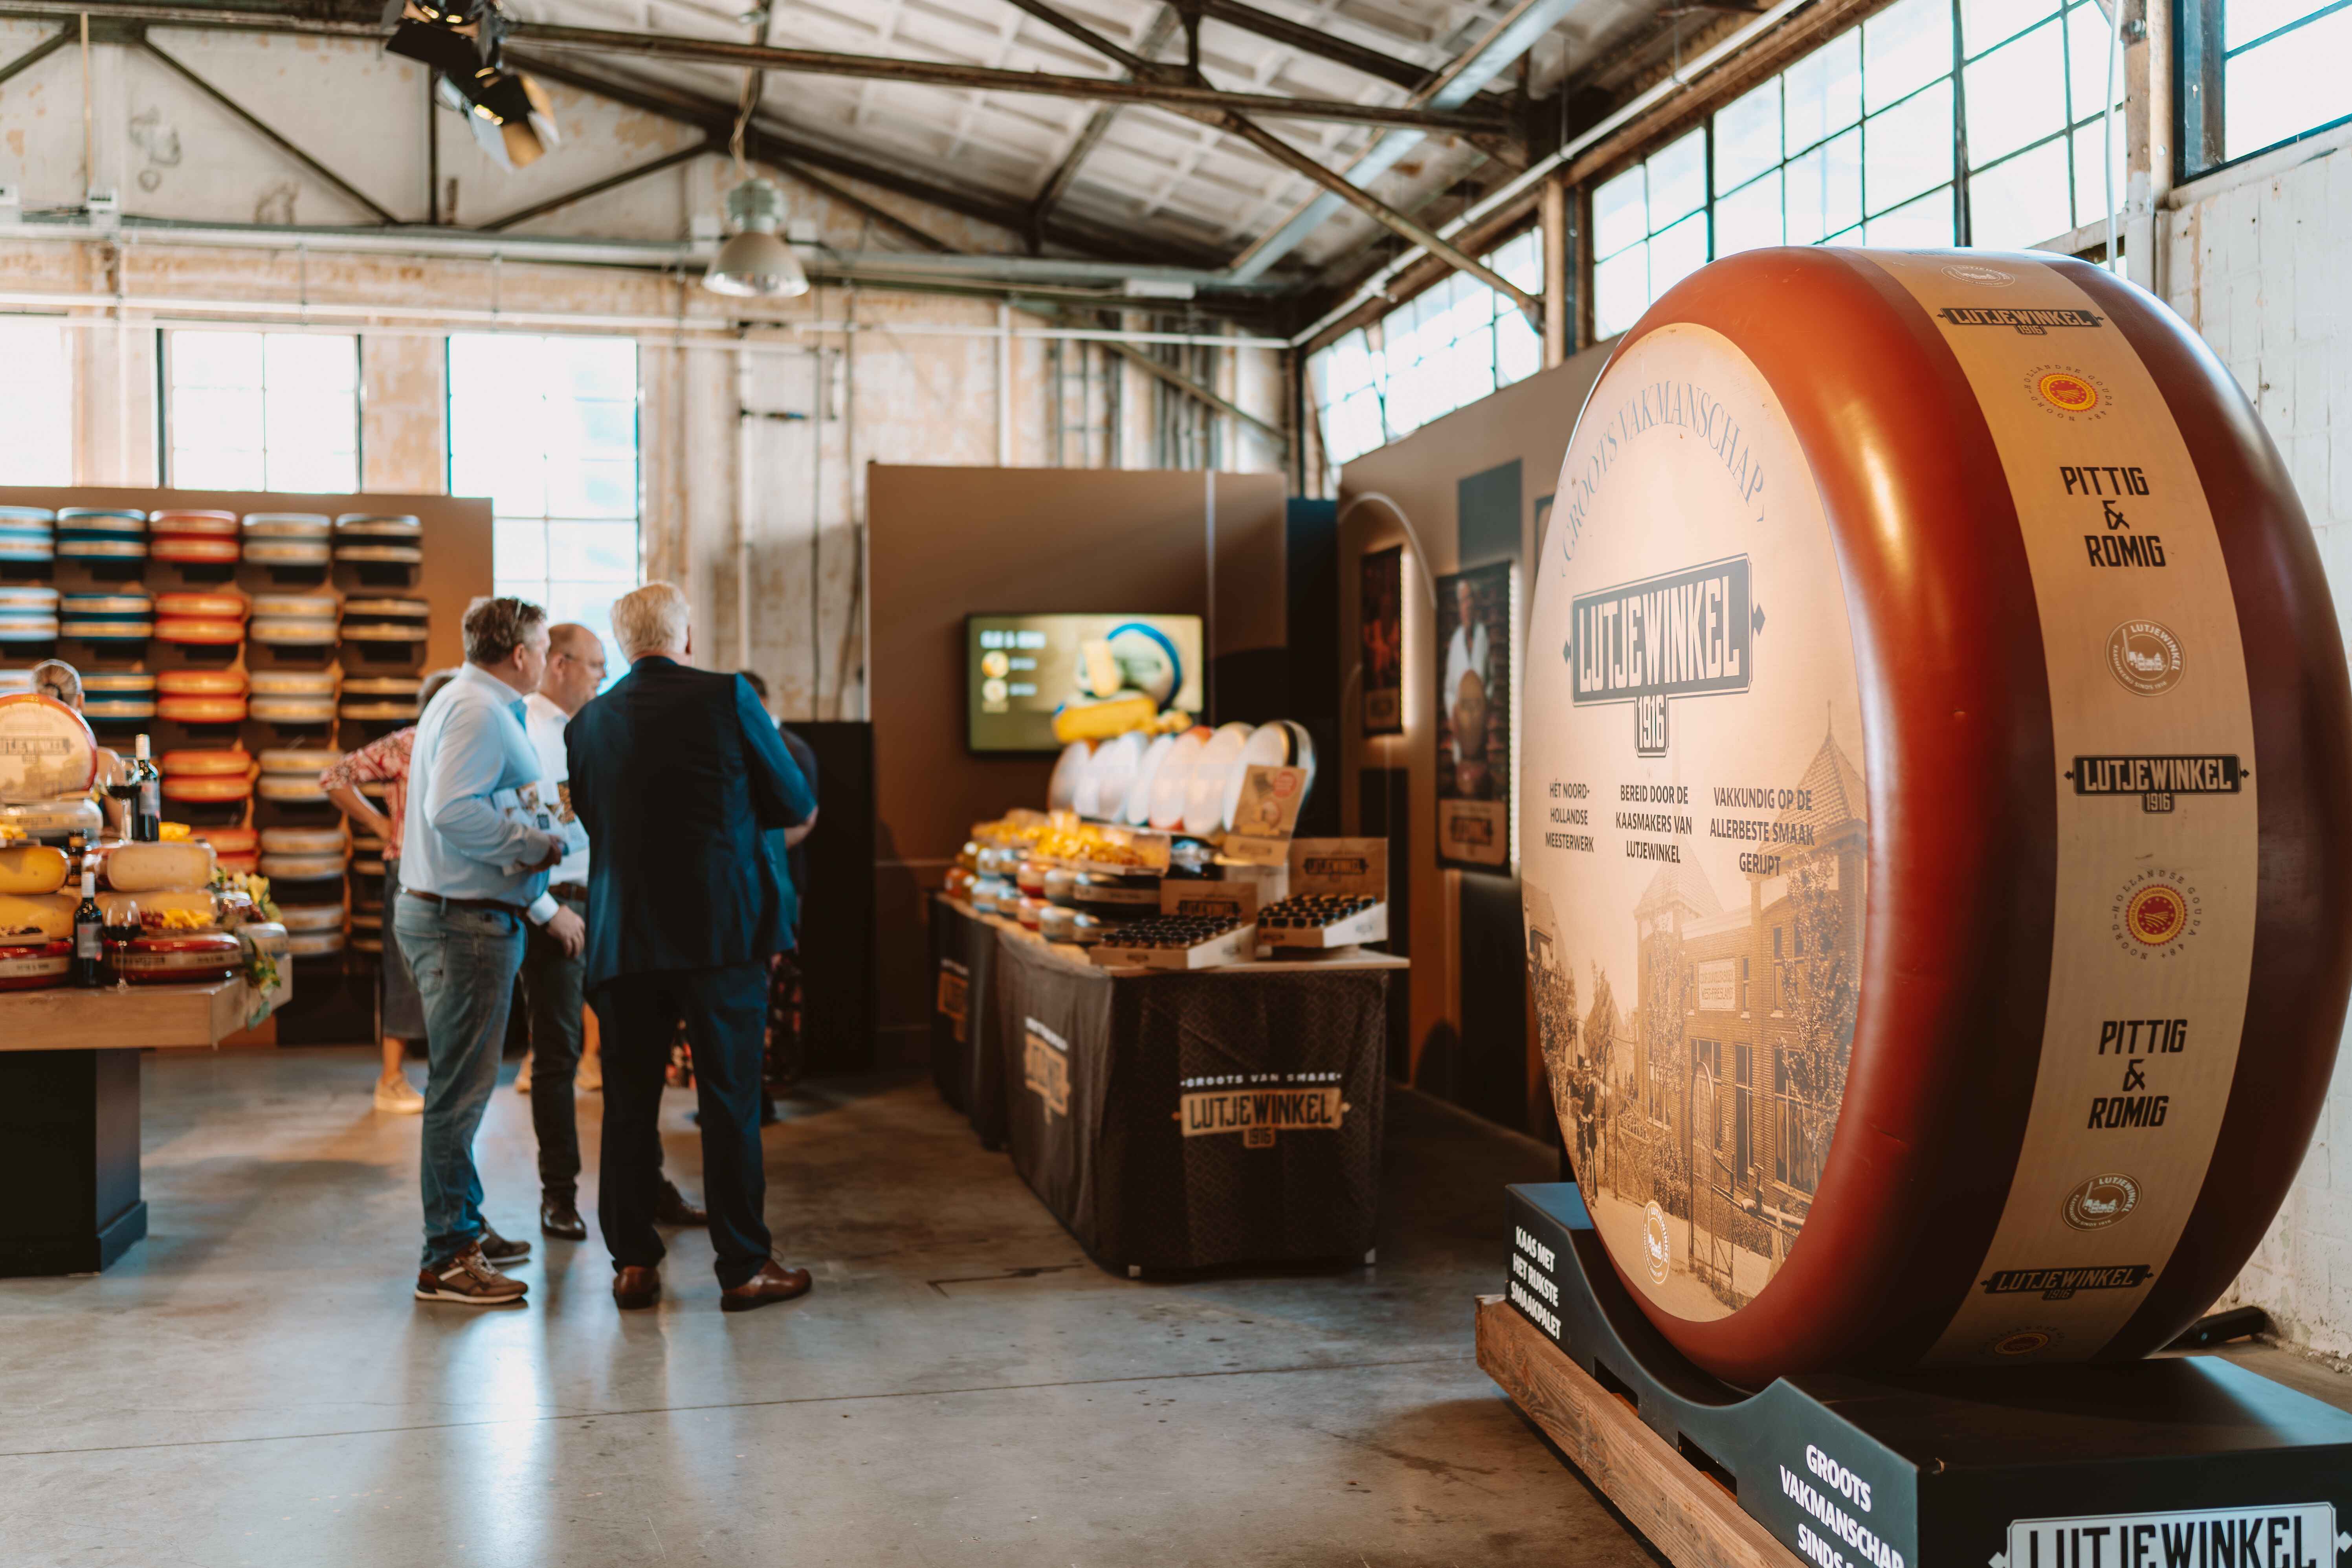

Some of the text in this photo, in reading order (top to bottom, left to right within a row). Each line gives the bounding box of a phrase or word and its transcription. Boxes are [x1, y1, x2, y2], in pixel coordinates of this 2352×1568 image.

[1950, 309, 2093, 326] LUTJEWINKEL
[2017, 325, 2043, 334] 1916
[2088, 375, 2112, 406] GOUDA
[1563, 381, 1764, 561] GROOTS VAKMANSCHAP
[2060, 466, 2150, 495] PITTIG
[2101, 500, 2130, 530] &
[2084, 536, 2166, 567] ROMIG
[1579, 576, 1739, 693] LUTJEWINKEL
[2130, 624, 2181, 670] LUTJEWINKEL
[1637, 694, 1666, 749] 1916
[2083, 759, 2232, 791] LUTJEWINKEL
[1563, 783, 1590, 799] NOORD-
[1620, 785, 1688, 804] BEREID DOOR DE
[1714, 787, 1812, 811] VAKKUNDIG OP DE
[2145, 793, 2171, 811] 1916
[1550, 807, 1588, 825] HOLLANDSE
[1616, 812, 1692, 835] KAASMAKERS VAN
[1545, 832, 1594, 853] MEESTERWERK
[1710, 818, 1815, 846] ALLERBESTE SMAAK
[1626, 840, 1681, 864] LUTJEWINKEL
[1739, 852, 1781, 876] GERIJPT
[2187, 887, 2202, 936] GOUDA
[2098, 1019, 2188, 1055] PITTIG
[1186, 1075, 1244, 1088] GROOTS
[1251, 1073, 1279, 1082] VAN
[2122, 1058, 2145, 1091] &
[1189, 1093, 1332, 1130] LUTJEWINKEL
[2088, 1096, 2169, 1129] ROMIG
[2099, 1177, 2136, 1212] LUTJEWINKEL
[1515, 1226, 1555, 1273] KAAS MET
[1651, 1207, 1668, 1264] LUTJEWINKEL
[1513, 1253, 1559, 1307] HET RIJKSTE
[1996, 1268, 2134, 1291] LUTJEWINKEL
[2047, 1289, 2071, 1299] 1916
[1511, 1281, 1561, 1340] SMAAKPALET
[1806, 1444, 1871, 1513] GROOTS
[1780, 1464, 1905, 1568] VAKMANSCHAP
[1798, 1523, 1843, 1568] SINDS
